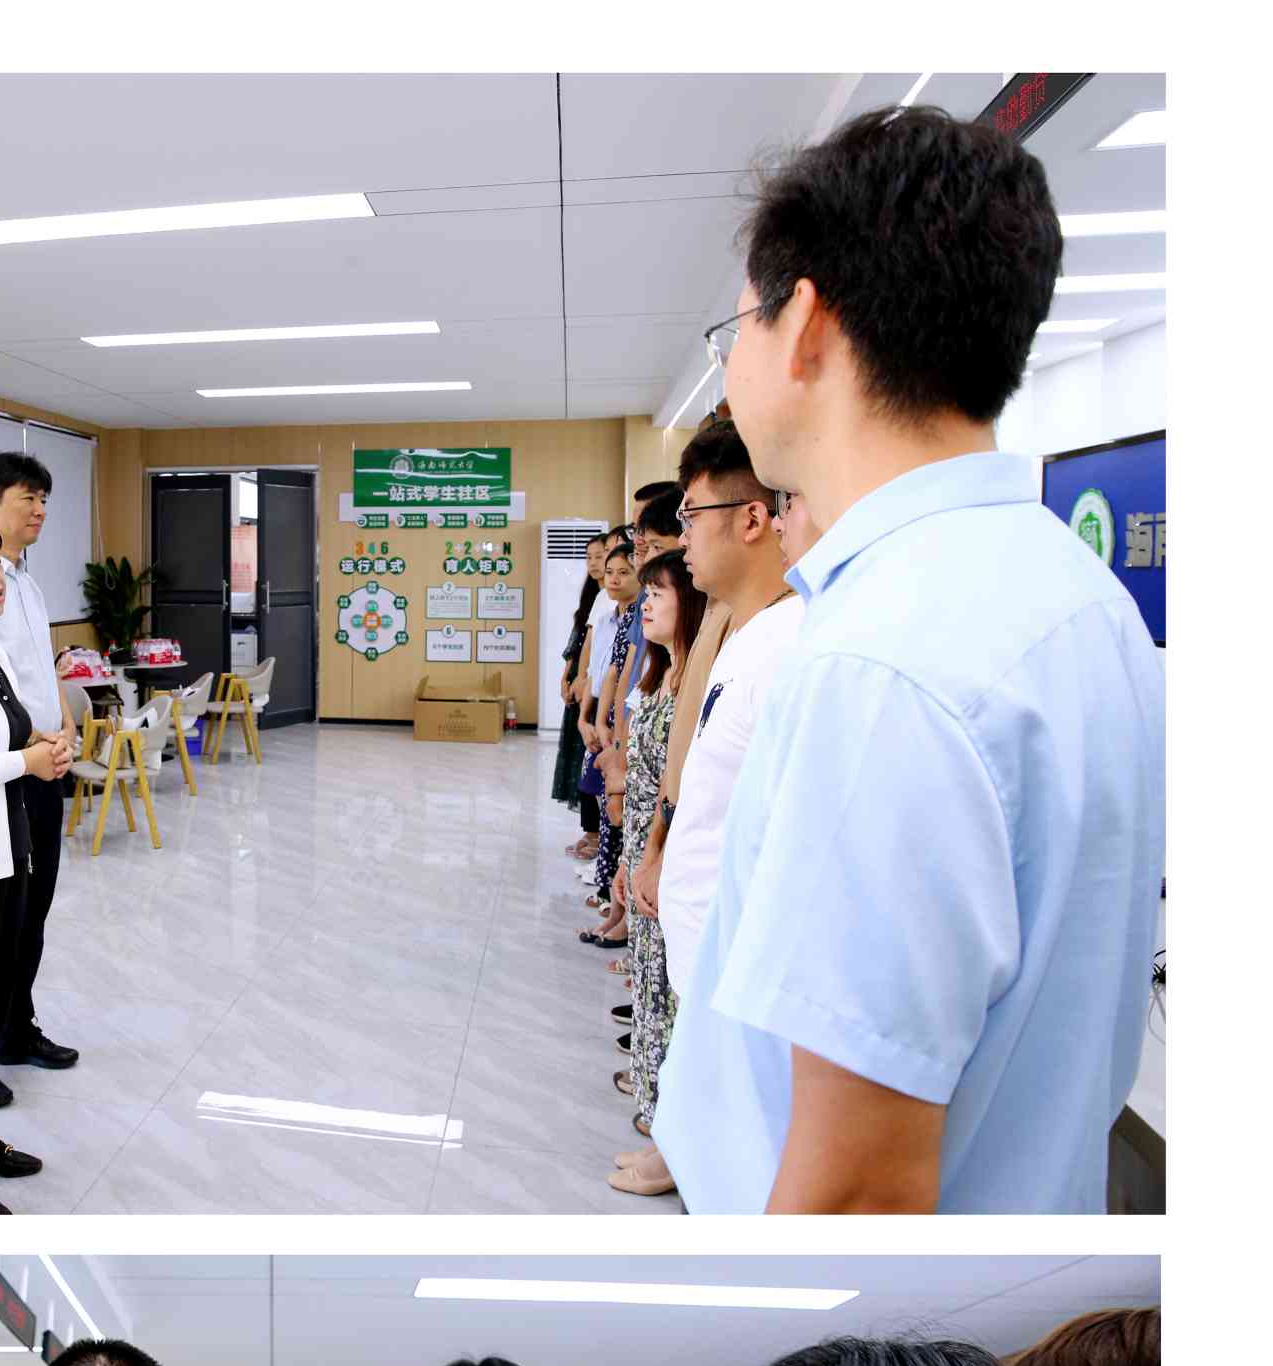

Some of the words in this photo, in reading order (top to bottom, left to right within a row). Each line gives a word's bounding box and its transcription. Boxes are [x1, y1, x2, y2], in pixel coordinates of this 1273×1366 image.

[372, 484, 492, 502] 一站式学生社区
[339, 558, 405, 575] 运行模式
[445, 558, 510, 575] 育人矩阵
